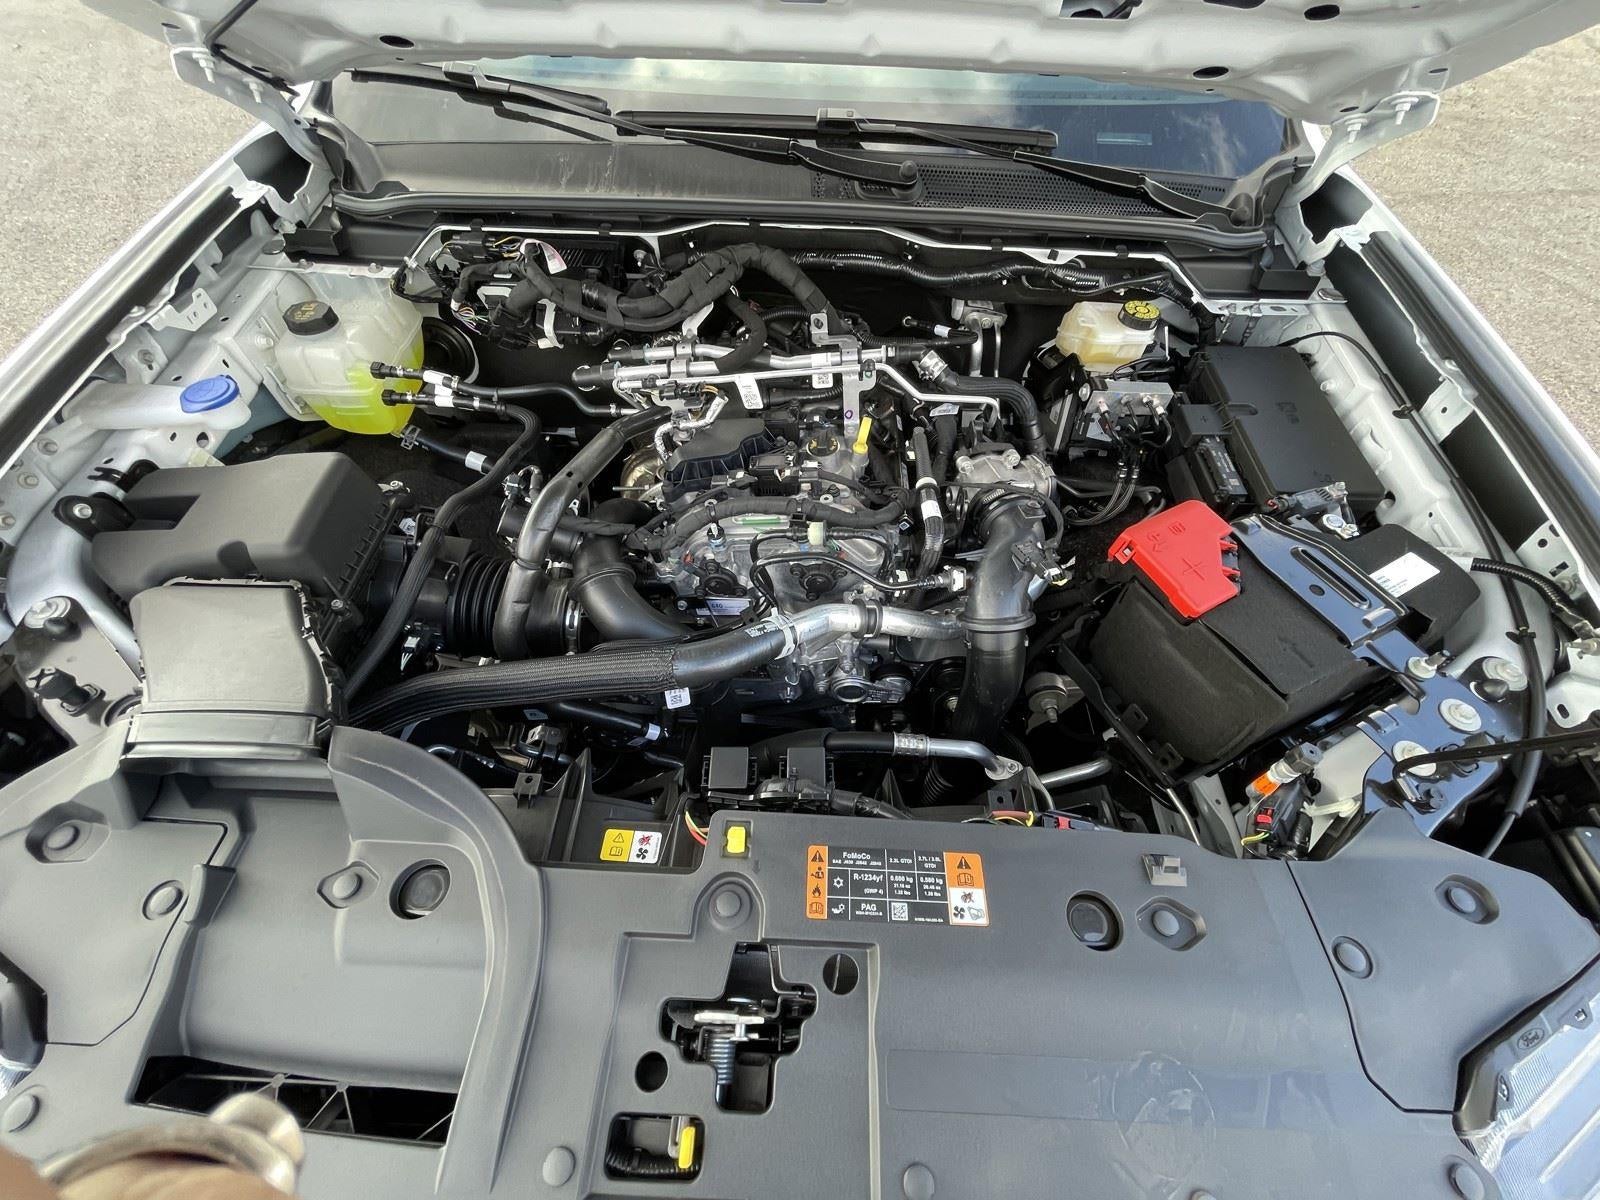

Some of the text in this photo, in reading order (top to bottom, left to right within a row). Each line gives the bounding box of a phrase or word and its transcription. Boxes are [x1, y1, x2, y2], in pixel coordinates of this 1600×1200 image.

[842, 851, 871, 860] FoMoCo
[853, 873, 883, 882] R-1234yf
[906, 875, 913, 884] kg
[936, 877, 943, 885] kg
